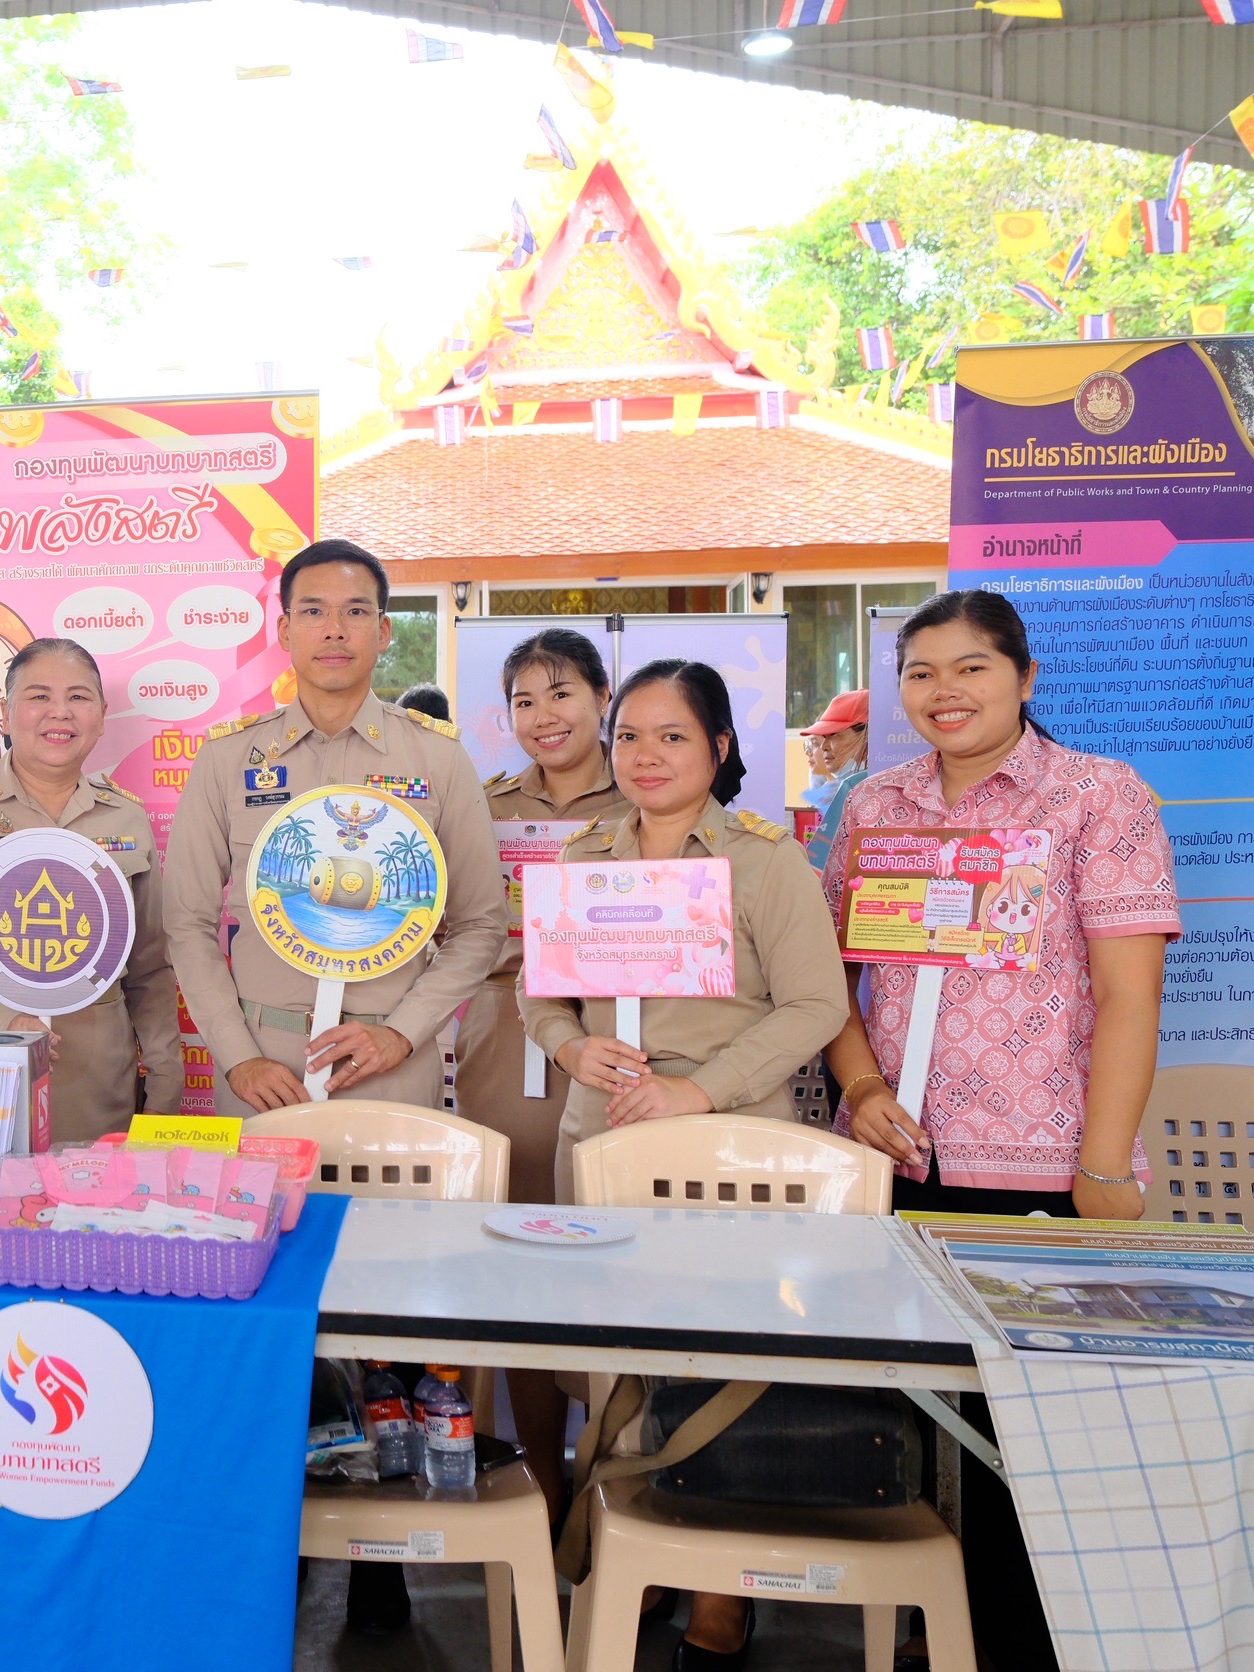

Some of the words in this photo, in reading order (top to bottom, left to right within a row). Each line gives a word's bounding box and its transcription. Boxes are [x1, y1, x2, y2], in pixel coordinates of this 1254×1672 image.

[13, 441, 277, 483] กองทุนพัฒนาบทบาทสตรี
[985, 437, 1227, 469] กรมโยธาธิการและผังเมือง
[984, 488, 1042, 500] Department
[1044, 488, 1054, 497] of
[1056, 487, 1085, 497] Public
[1087, 487, 1114, 496] Works
[1116, 486, 1133, 495] and
[1135, 486, 1160, 495] Town
[1162, 485, 1170, 494] &
[1172, 485, 1211, 497] Country
[1213, 484, 1253, 496] Planning
[982, 529, 1083, 558] อำนาจหน้าที่
[9, 560, 63, 581] สร้างรายได้
[66, 560, 140, 579] พัฒนาศักยภาพ
[143, 556, 265, 576] ยกระดับคุณภาพชีวิตสตรี
[980, 574, 1144, 594] กรมโยธาธิการและผังเมือง
[1149, 570, 1254, 589] เป็นหน่วยงานในสัง
[1012, 594, 1195, 613] กับงานด้านการผังเมืองระดับต่างๆ
[1200, 591, 1254, 608] การโยธาธิ
[63, 605, 145, 630] ดอกเบี้ยต่ำ
[182, 606, 250, 627] ชำระง่าย
[1025, 613, 1185, 636] ควบคุมการก่อสร้างอาคาร
[1191, 614, 1254, 629] ดำเนินการ
[1028, 635, 1154, 654] งถิ่นในการพัฒนาเมือง
[1160, 633, 1189, 650] พื้นที่
[1195, 636, 1248, 649] และชนบท
[1037, 655, 1138, 674] ารใช้ประโยชน์ที่ดิน
[138, 682, 209, 701] วงเงินสูง
[1060, 693, 1214, 715] เพื่อให้มีสภาพแวดล้อมที่ดี
[1052, 714, 1254, 736] ความเป็นระเบียบเรียบร้อยของบ้านเมื
[153, 730, 205, 760] เงิน
[1070, 733, 1254, 756] อันจะนำไปสู่การพัฒนาอย่างยั่งยื
[861, 834, 939, 852] กองทุนพัฒนา
[960, 845, 1000, 858] รับสมัคร
[1169, 831, 1233, 847] การผังเมือง
[1238, 832, 1254, 844] กา
[859, 850, 937, 870] บทบาทสตรี
[959, 856, 998, 871] สมาชิก
[1174, 851, 1220, 866] แวดล้อม
[877, 883, 910, 892] คุณสมบัติ
[929, 887, 970, 896] วิธีการสมัคร
[595, 906, 655, 920] คลินิกเคลื่อนที่
[539, 926, 717, 946] กองทุนพัฒนาบทบาทสตรี
[576, 948, 677, 963] จังหวัดสมุทรสงคราม
[1164, 948, 1254, 964] องต่อความต้อ
[1160, 989, 1223, 1003] ละประชาชน
[1191, 1027, 1254, 1041] และประสิทธิ
[1079, 1335, 1254, 1355] บ้านอารยสถาปัต
[11, 1439, 81, 1454] กองทุนพัฒนา
[29, 1474, 89, 1487] Empowerment
[91, 1477, 116, 1488] Funds
[363, 1547, 404, 1556] SAHACHAI
[756, 1578, 802, 1590] SAHACHAI
